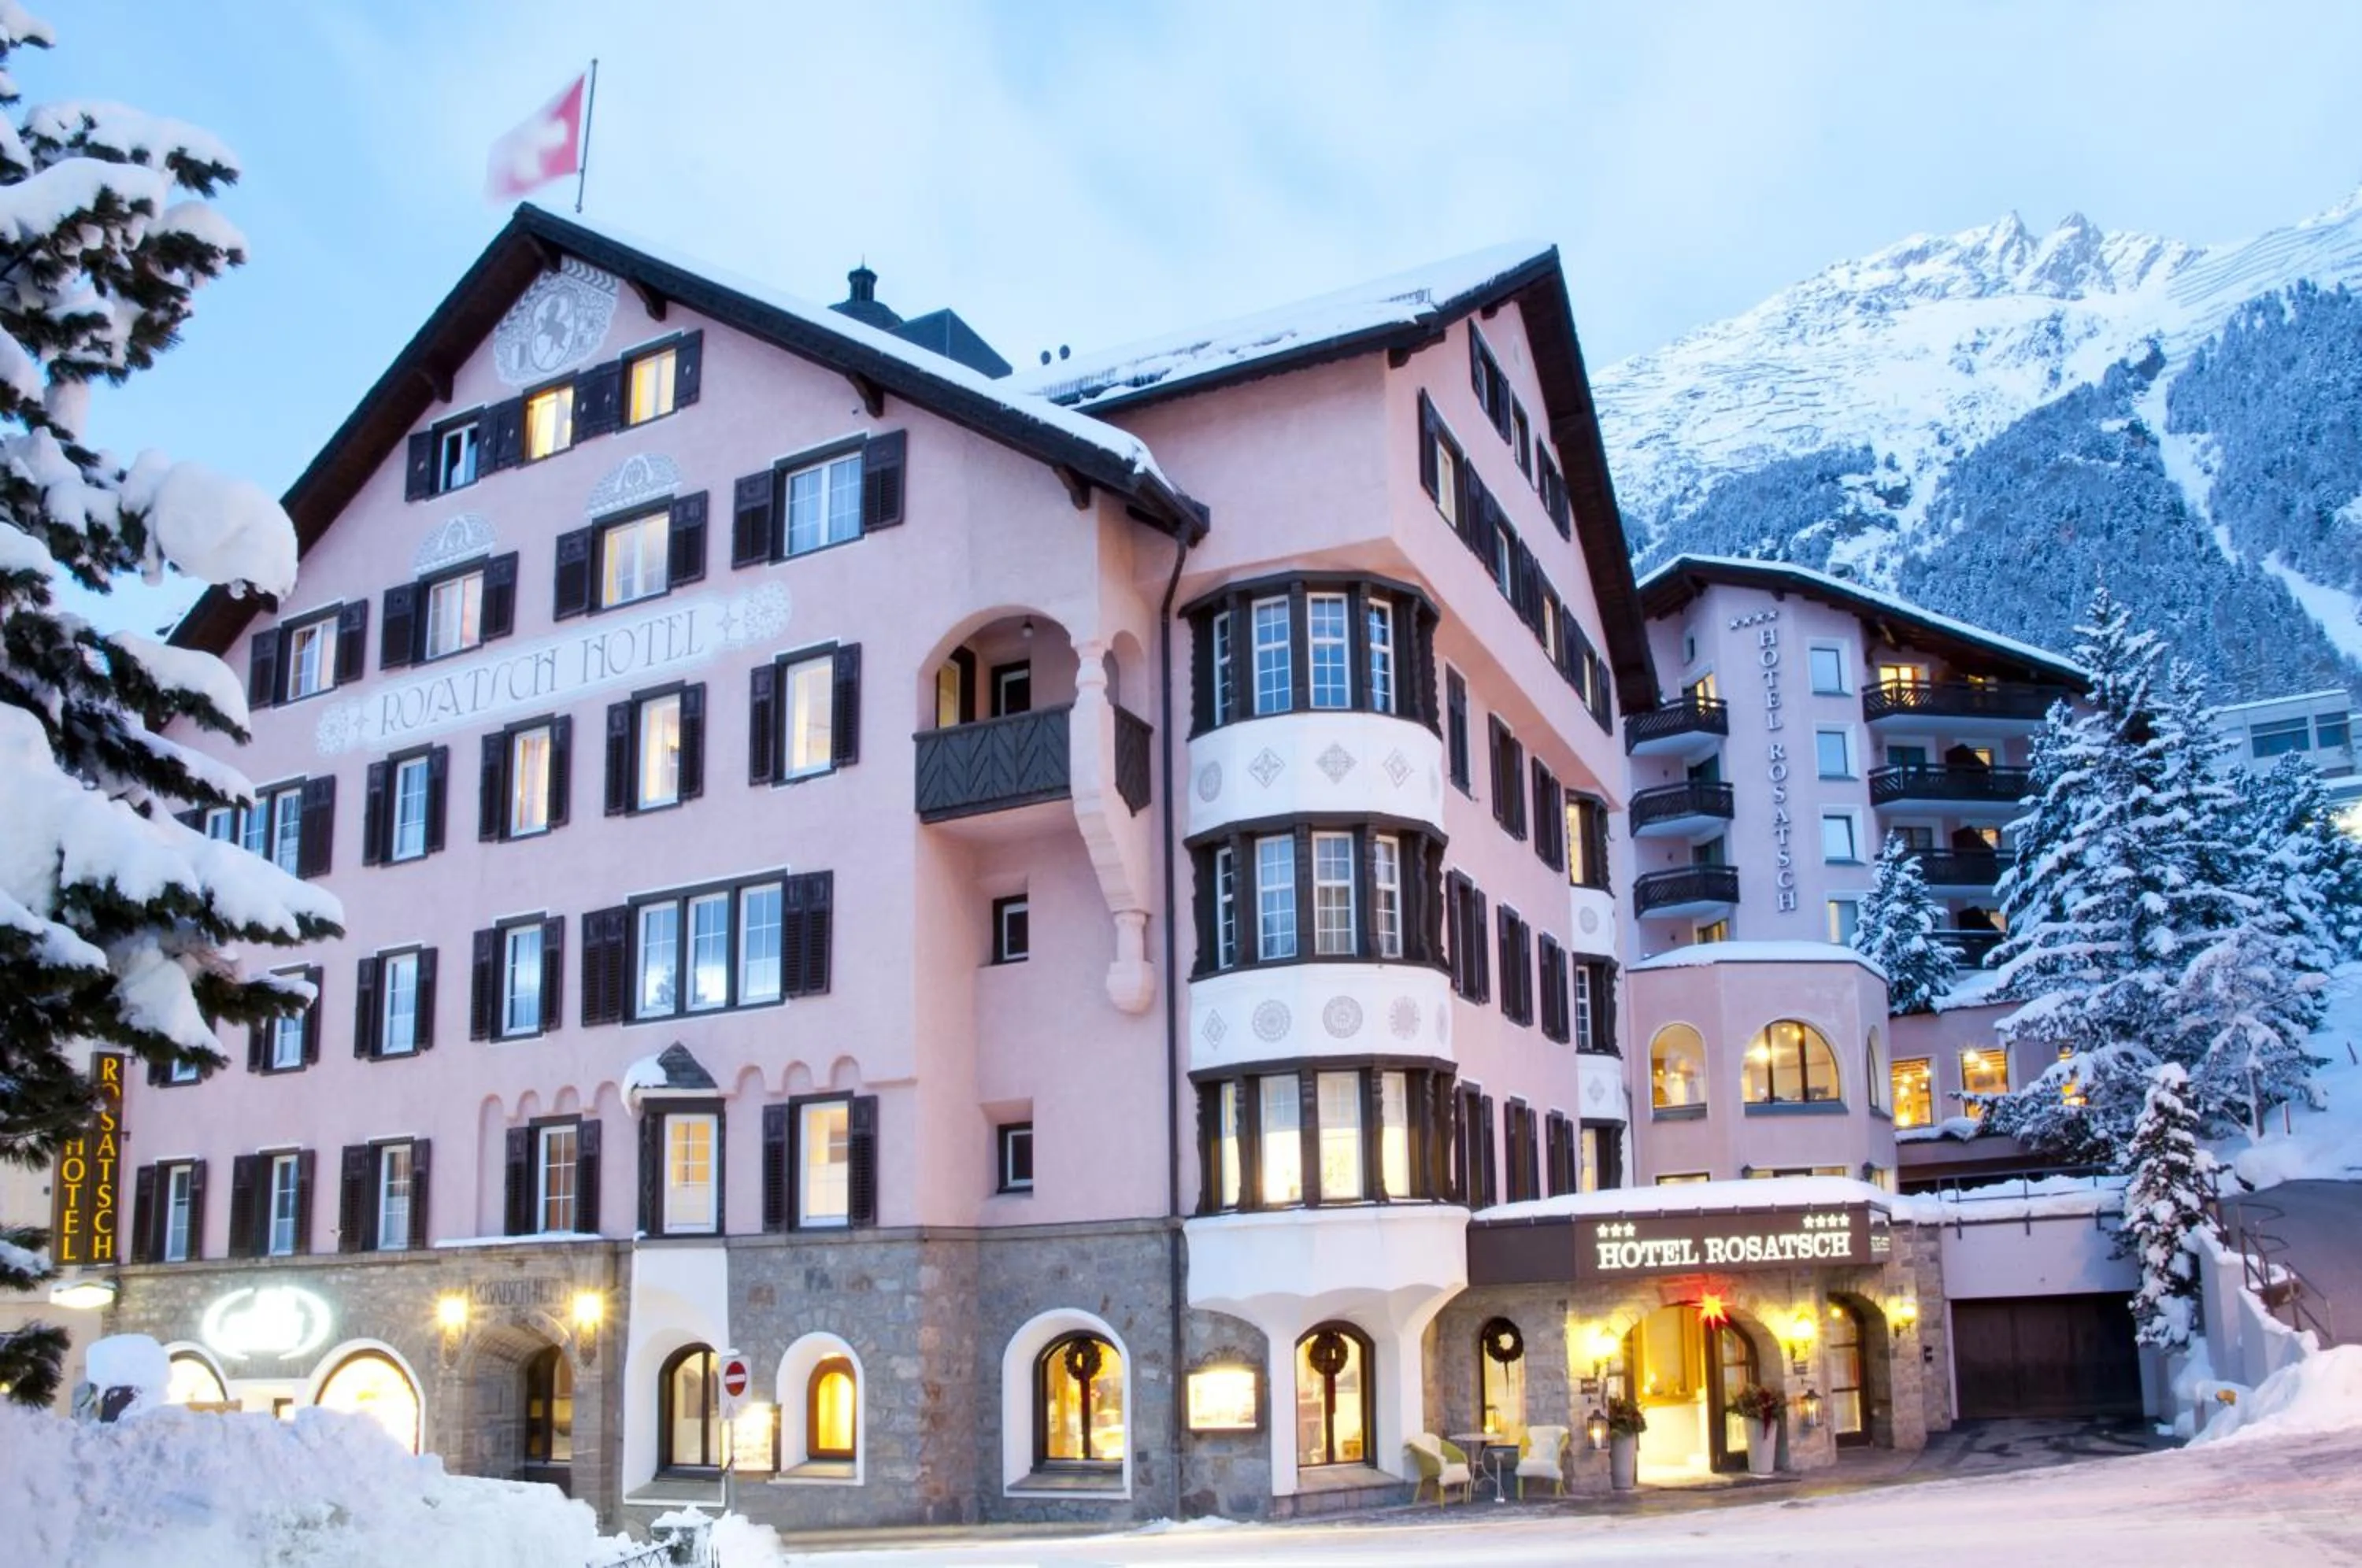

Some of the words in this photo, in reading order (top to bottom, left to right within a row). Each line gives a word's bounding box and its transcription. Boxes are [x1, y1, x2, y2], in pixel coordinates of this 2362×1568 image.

[381, 648, 559, 736] ROSATSCH
[581, 609, 705, 684] HOTEL
[1759, 629, 1783, 730] HOTEL
[1768, 742, 1797, 912] ROSATSCH
[62, 1139, 86, 1260] HOTEL
[1597, 1239, 1699, 1270] HOTEL
[1704, 1232, 1852, 1264] ROSATSCH
